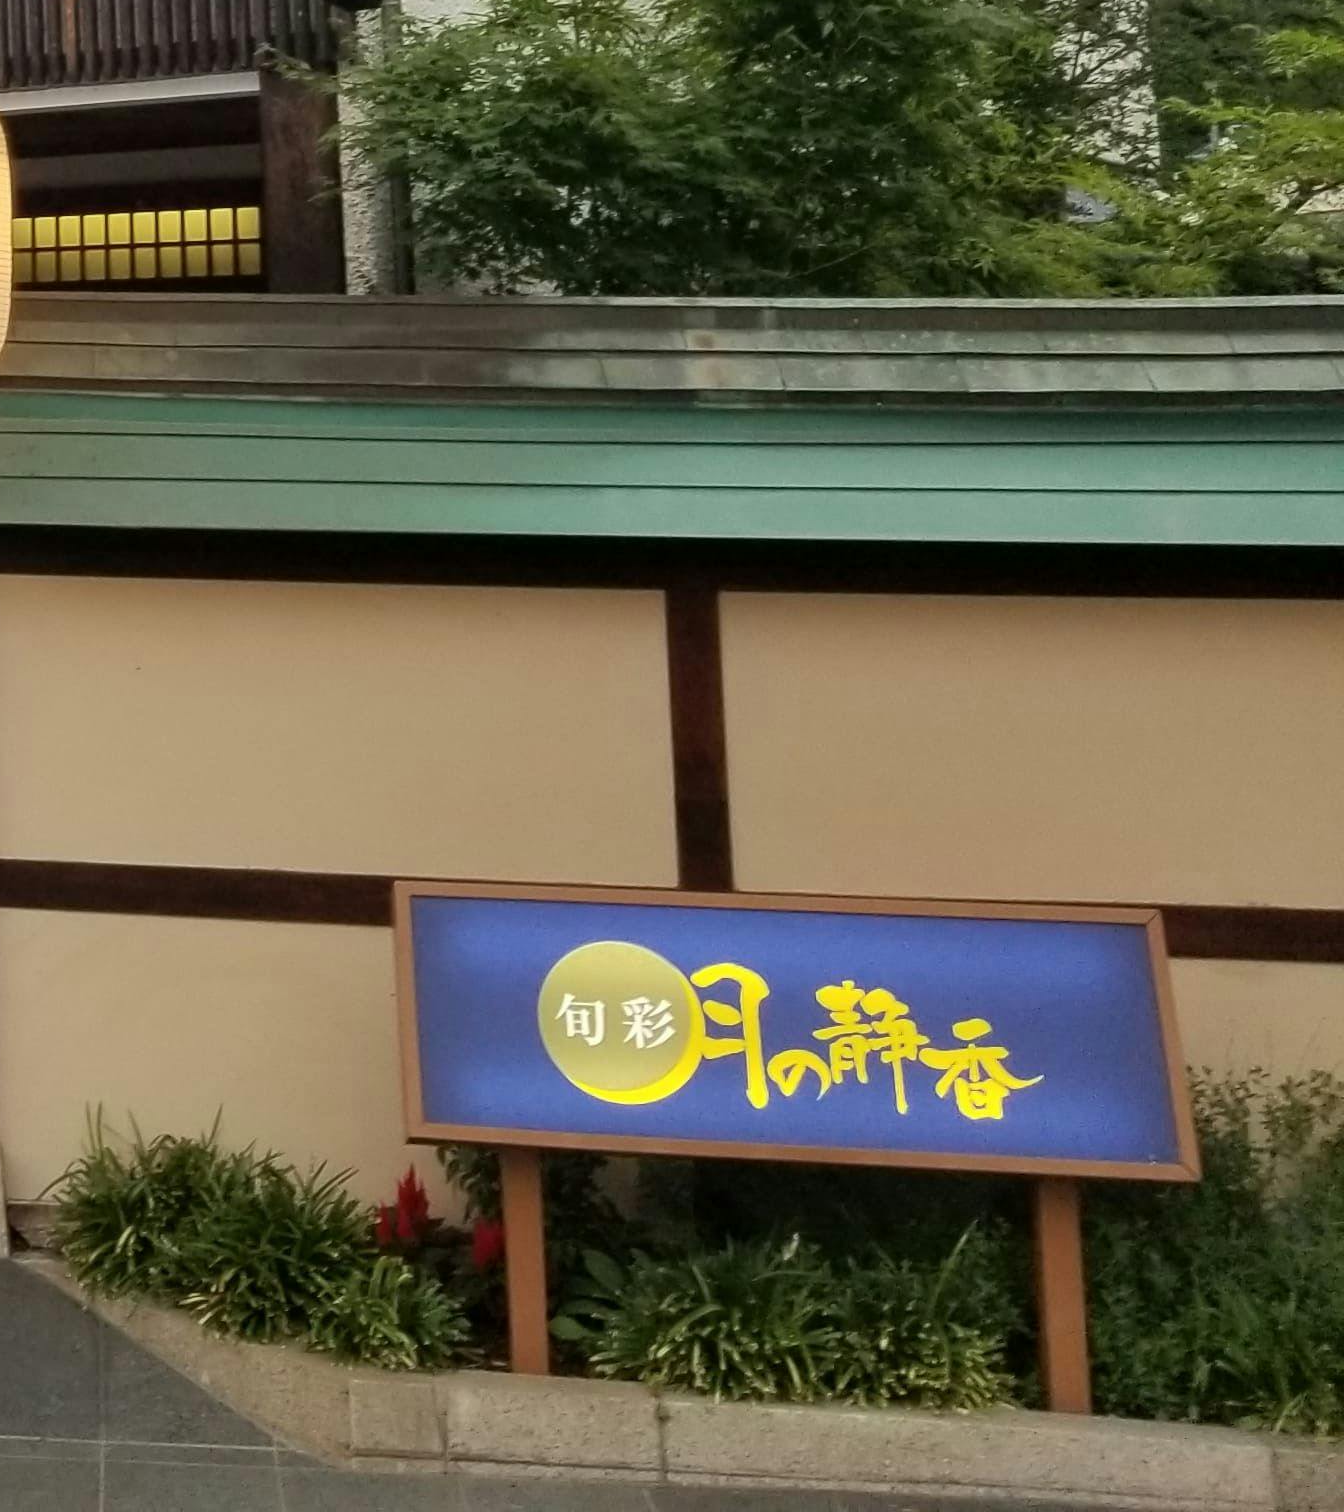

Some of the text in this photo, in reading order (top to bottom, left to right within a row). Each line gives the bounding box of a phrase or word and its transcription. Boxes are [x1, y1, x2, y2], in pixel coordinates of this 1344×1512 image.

[554, 992, 678, 1050] 旬彩
[690, 961, 1044, 1121] 月の静香
